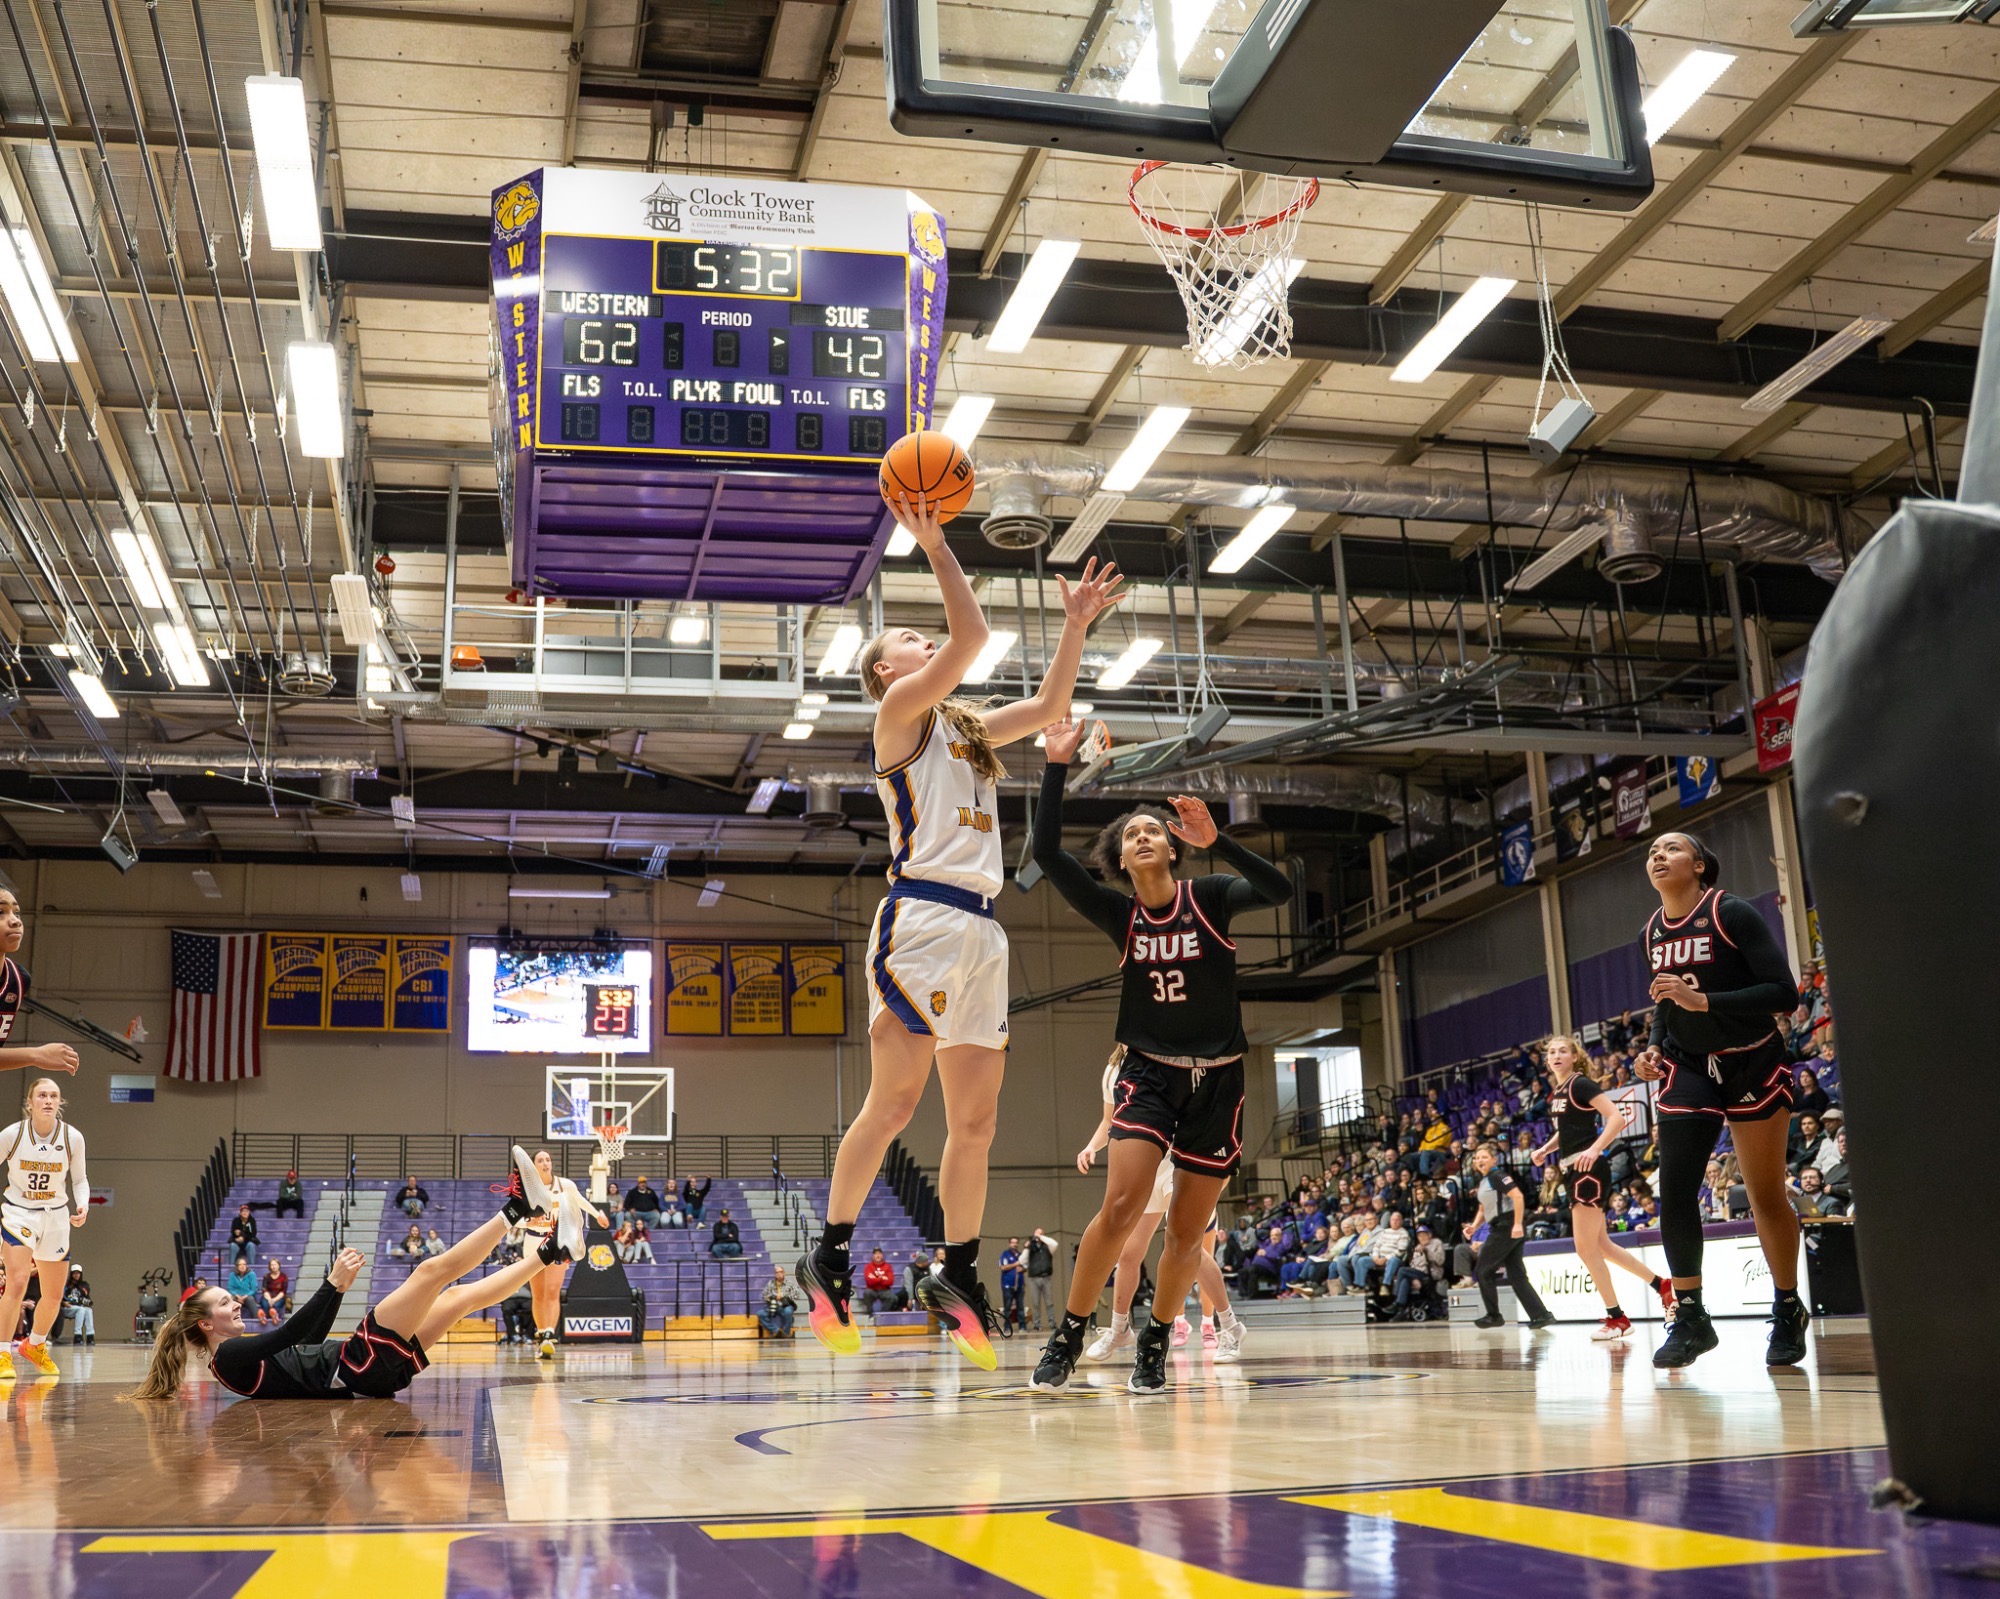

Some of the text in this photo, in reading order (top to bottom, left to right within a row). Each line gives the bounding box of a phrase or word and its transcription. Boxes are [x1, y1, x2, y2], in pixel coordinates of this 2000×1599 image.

[690, 188, 815, 211] Clock Tower
[689, 204, 815, 224] Community Bank
[694, 247, 792, 293] 5:32
[561, 292, 649, 317] WESTERN
[701, 311, 752, 327] PERIOD
[825, 306, 869, 329] SIUE
[507, 241, 531, 450] WSTERN
[580, 321, 636, 365] 62
[828, 336, 882, 377] 42
[563, 375, 600, 397] FLS
[623, 381, 662, 397] T.O.L.
[673, 379, 781, 405] PLYR FOUL
[791, 390, 830, 405] T.O.L.
[850, 388, 886, 411] FLS
[1771, 728, 1792, 748] SEM
[1134, 931, 1200, 961] SIUE
[1651, 936, 1711, 970] SIUE
[682, 985, 708, 996] NCAA
[1149, 969, 1187, 1003] 32
[598, 990, 633, 1007] 5:32
[0, 1014, 15, 1039] E
[594, 1006, 627, 1032] 23
[28, 1173, 50, 1190] 32
[1540, 1265, 1598, 1295] Nutrie
[567, 1319, 630, 1332] WGEM
